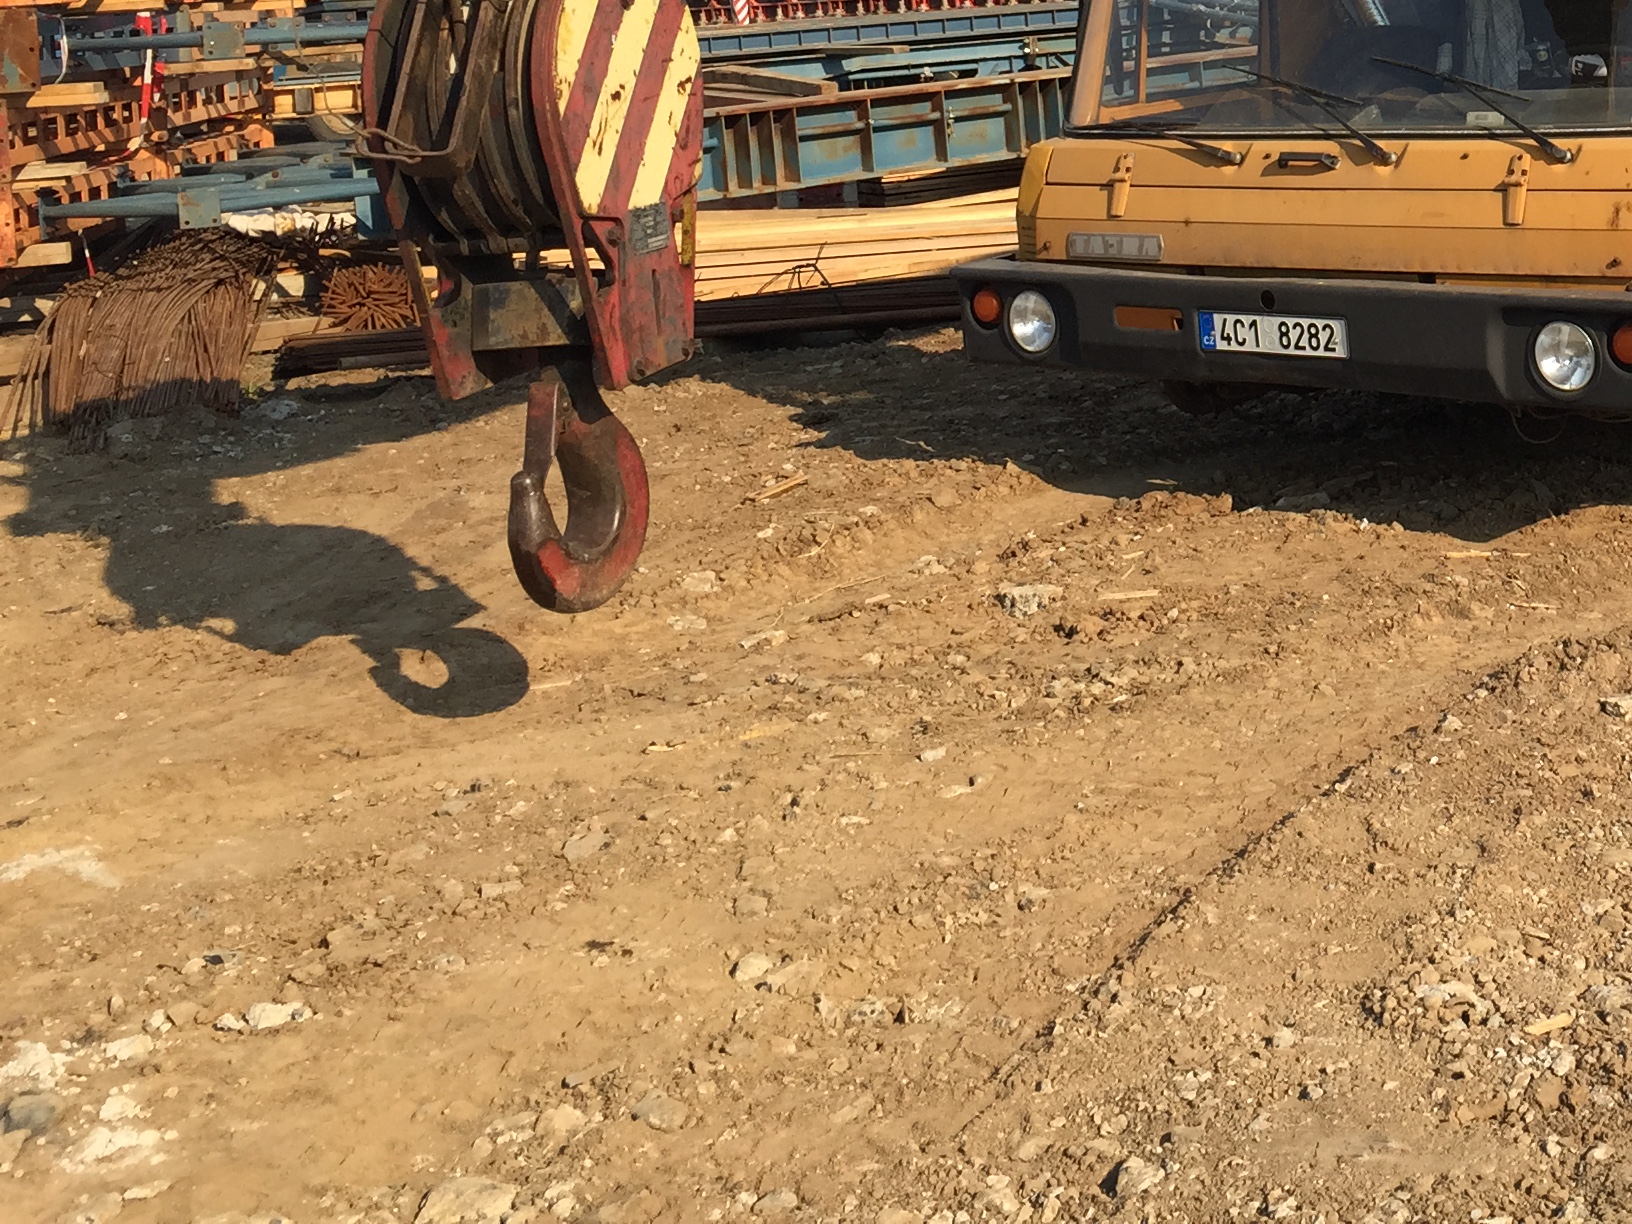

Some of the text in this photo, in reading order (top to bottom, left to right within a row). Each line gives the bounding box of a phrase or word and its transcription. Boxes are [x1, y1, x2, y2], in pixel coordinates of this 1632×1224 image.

[1203, 336, 1215, 345] CZ
[1220, 317, 1337, 352] 4C1 8282
